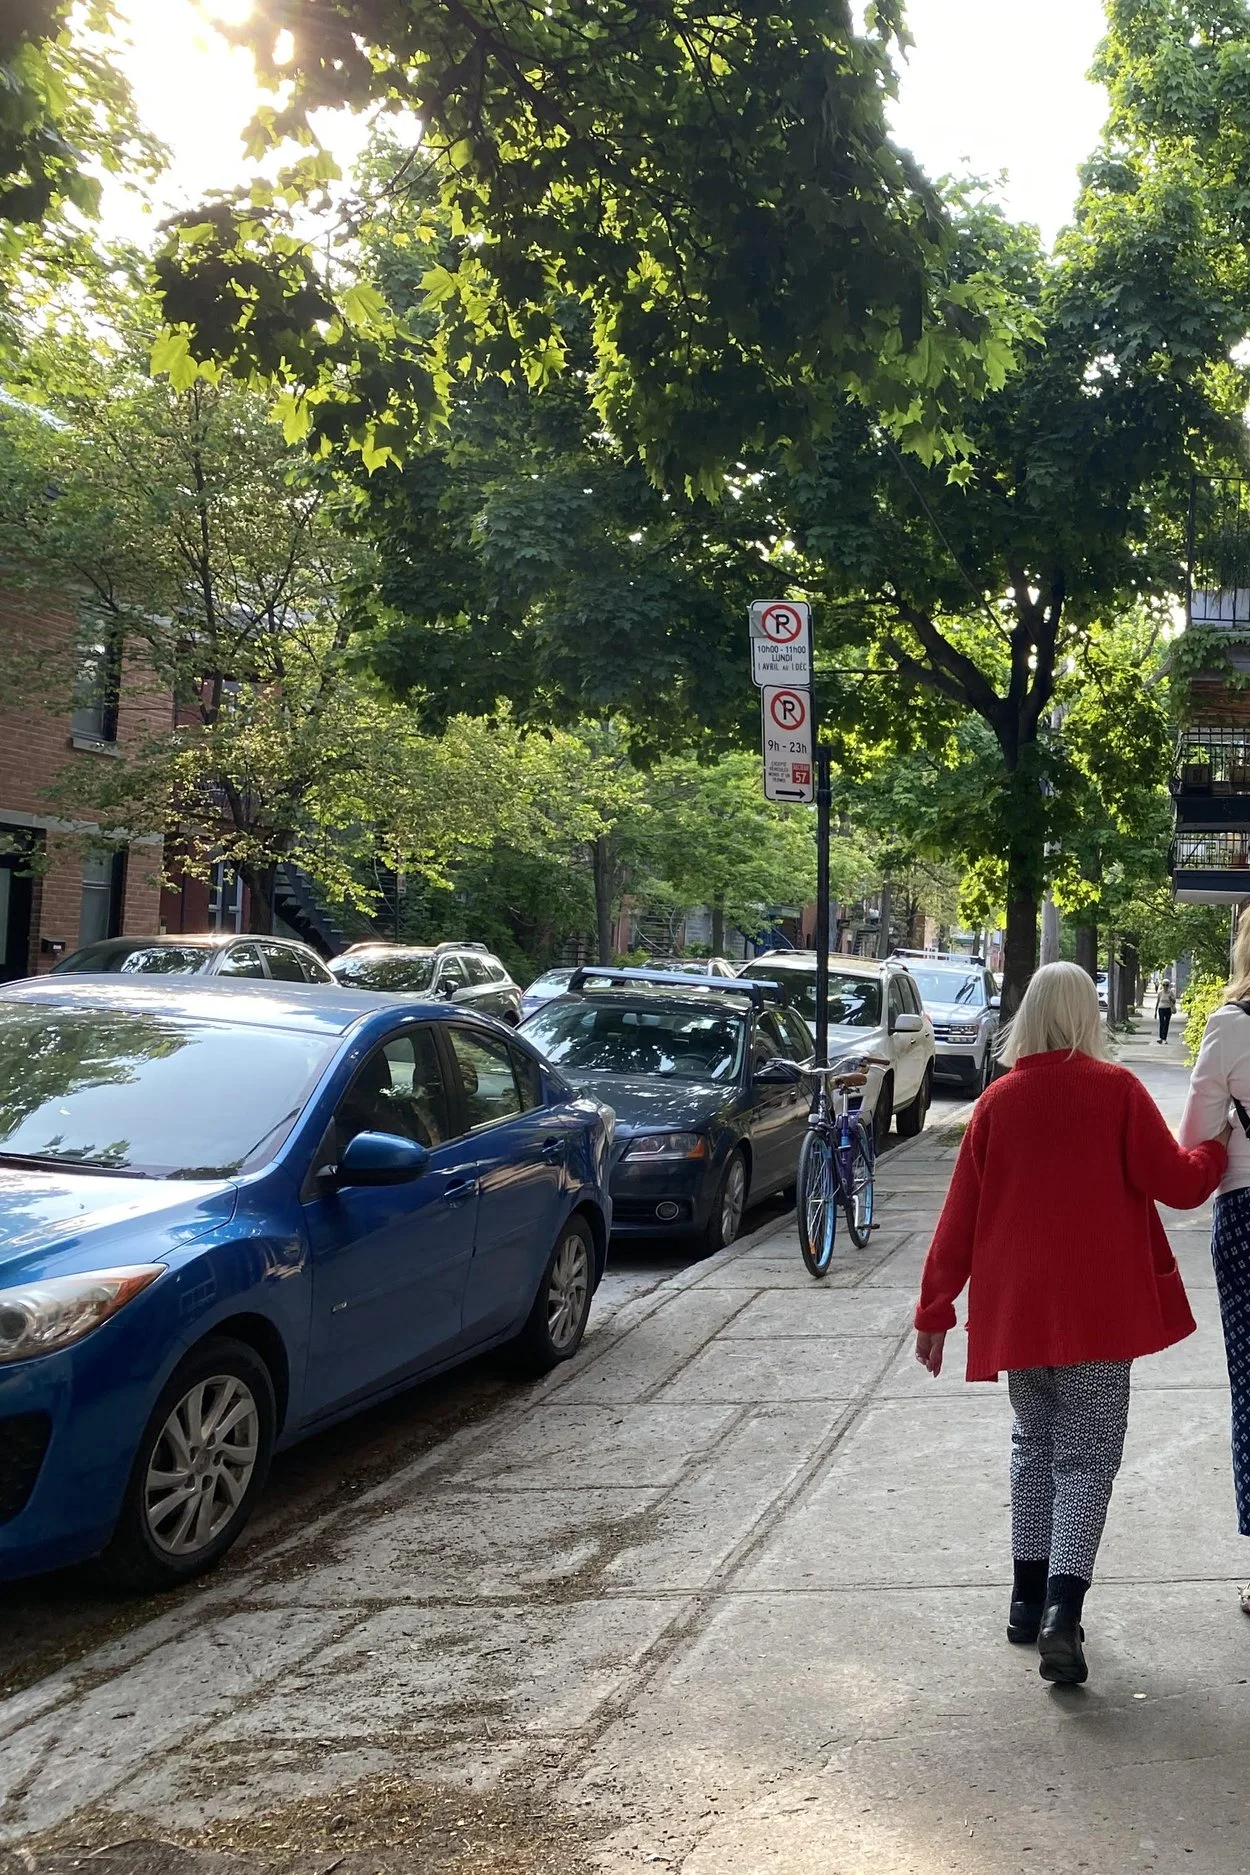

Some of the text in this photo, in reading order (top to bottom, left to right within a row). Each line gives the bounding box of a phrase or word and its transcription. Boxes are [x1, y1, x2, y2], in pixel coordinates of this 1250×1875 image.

[757, 645, 779, 653] 10h00
[785, 646, 806, 654] 11h00
[771, 654, 793, 662] LUNDI
[762, 663, 779, 671] AVRIL
[768, 740, 780, 752] 9h
[789, 741, 807, 753] 23h
[795, 772, 807, 783] 57
